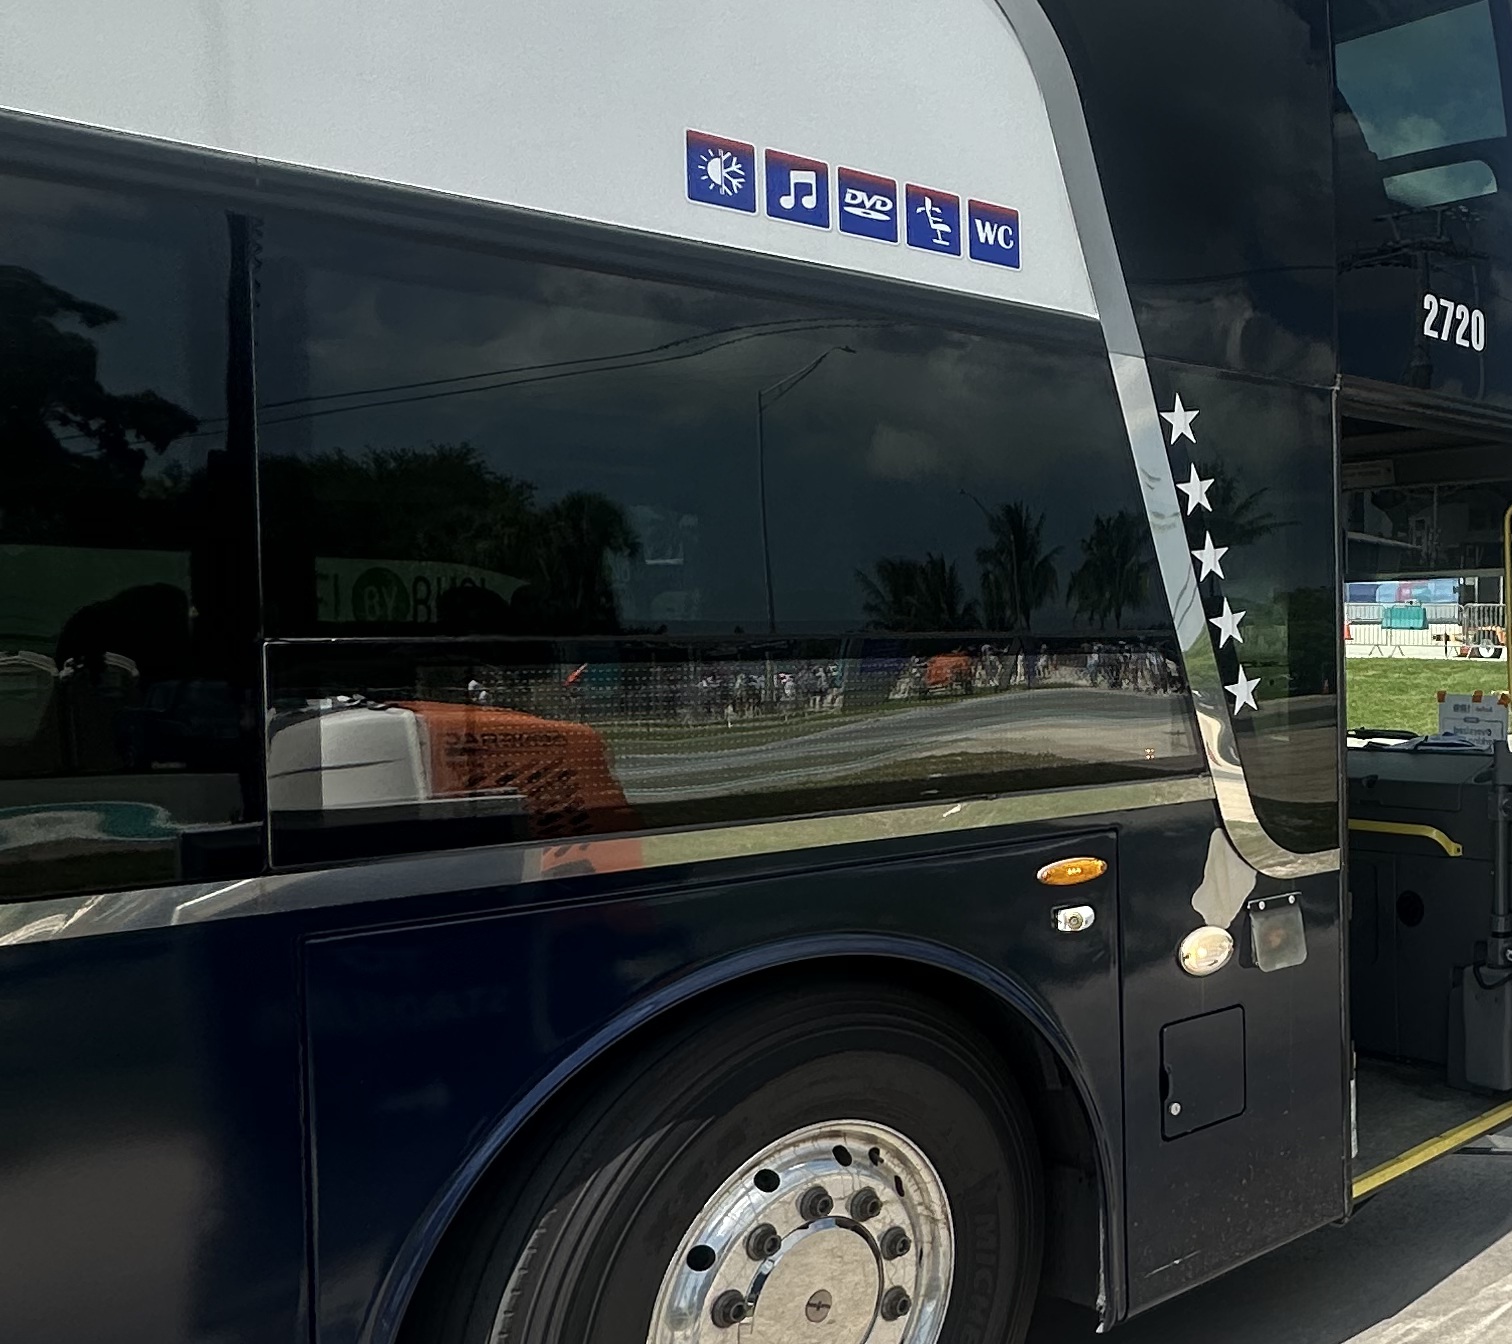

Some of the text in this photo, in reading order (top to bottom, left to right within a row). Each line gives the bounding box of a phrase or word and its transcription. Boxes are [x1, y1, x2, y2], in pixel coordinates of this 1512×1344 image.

[844, 188, 893, 211] DVD
[974, 219, 1014, 249] WC
[1423, 293, 1485, 352] 2720
